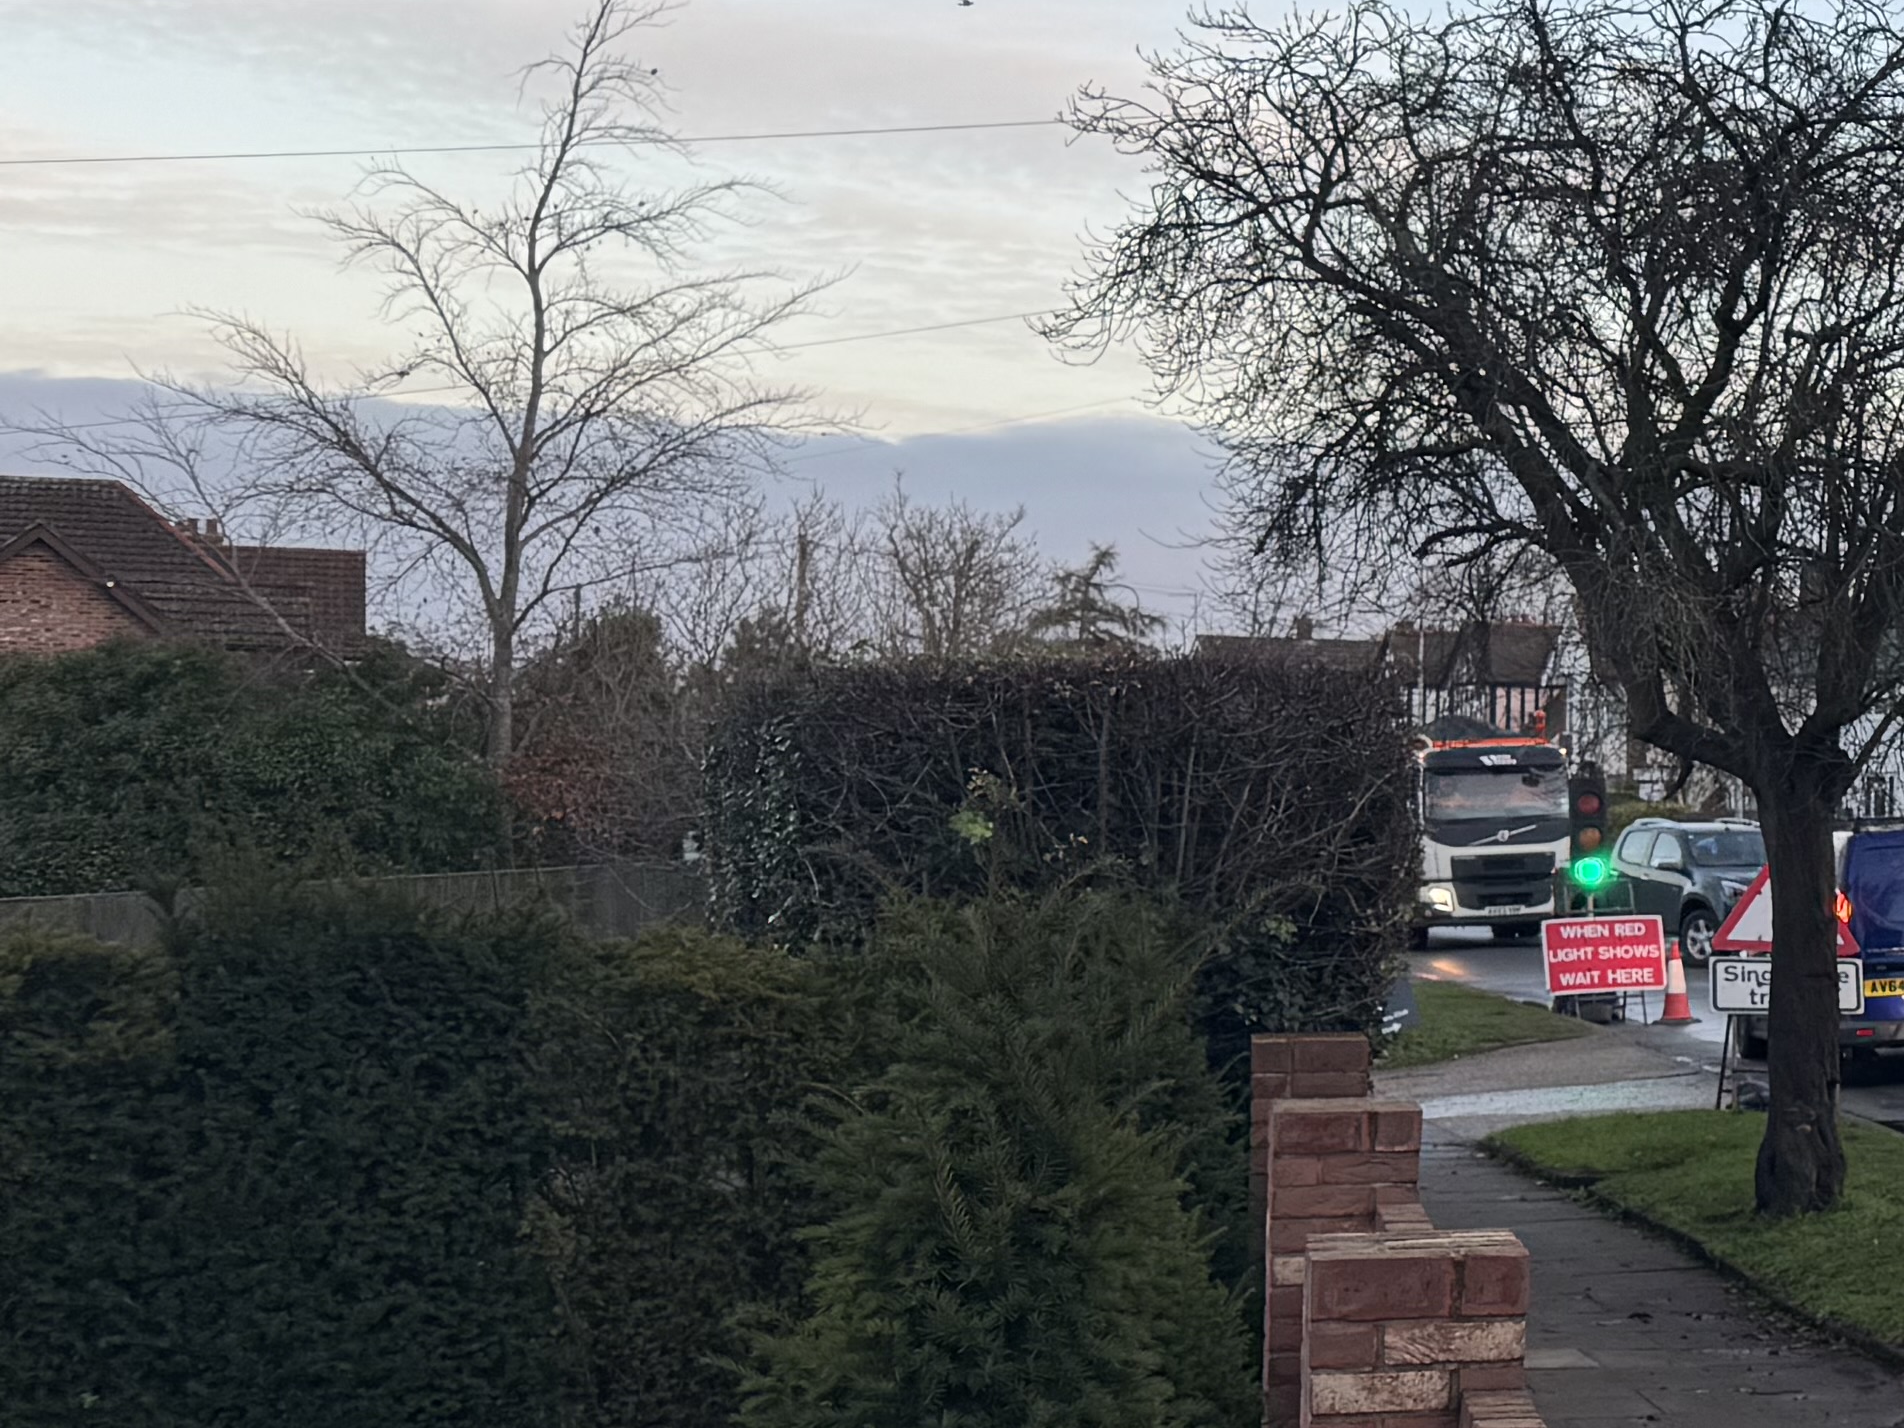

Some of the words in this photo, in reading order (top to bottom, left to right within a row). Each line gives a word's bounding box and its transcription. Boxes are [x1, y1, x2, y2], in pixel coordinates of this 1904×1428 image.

[1560, 923, 1610, 939] WHEN
[1614, 922, 1646, 937] RED
[1549, 946, 1595, 963] LIGHT
[1598, 944, 1660, 960] SHOWS
[1559, 970, 1601, 987] WAIT
[1607, 967, 1655, 984] HERE
[1870, 979, 1904, 993] AV64
